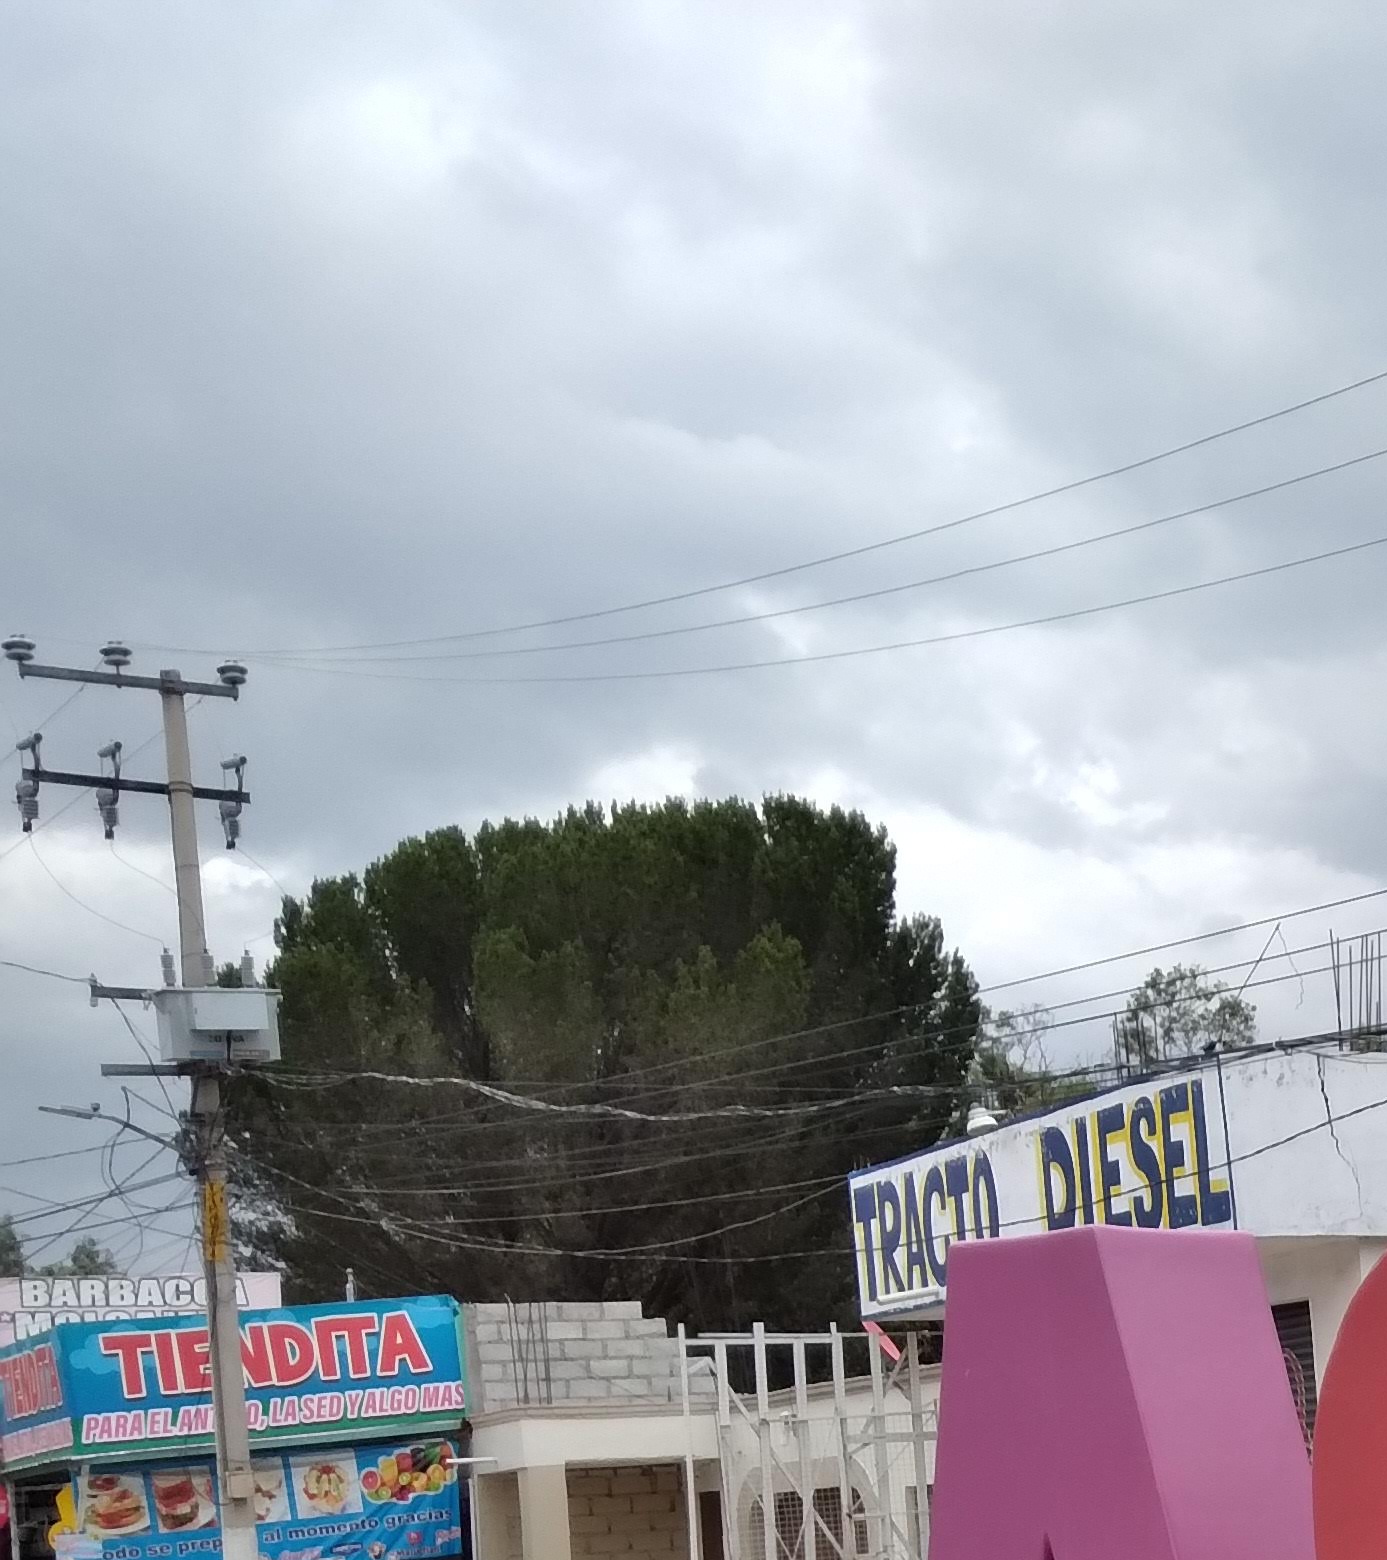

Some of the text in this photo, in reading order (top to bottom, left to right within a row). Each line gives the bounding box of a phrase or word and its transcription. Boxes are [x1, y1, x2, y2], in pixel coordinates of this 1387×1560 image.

[854, 1077, 1232, 1302] TRACTO DIESEL
[98, 1311, 433, 1399] TIENDITA
[82, 1411, 145, 1444] PARA
[148, 1408, 178, 1440] EL
[270, 1396, 300, 1425] LA
[301, 1391, 344, 1423] SED
[345, 1389, 361, 1419] Y
[361, 1384, 420, 1417] ALGO
[420, 1381, 465, 1410] MAS
[102, 1544, 141, 1560] odo
[147, 1543, 172, 1556] se
[177, 1538, 223, 1557] prep
[263, 1528, 281, 1543] al
[288, 1516, 379, 1540] momento
[384, 1508, 452, 1530] gracias
